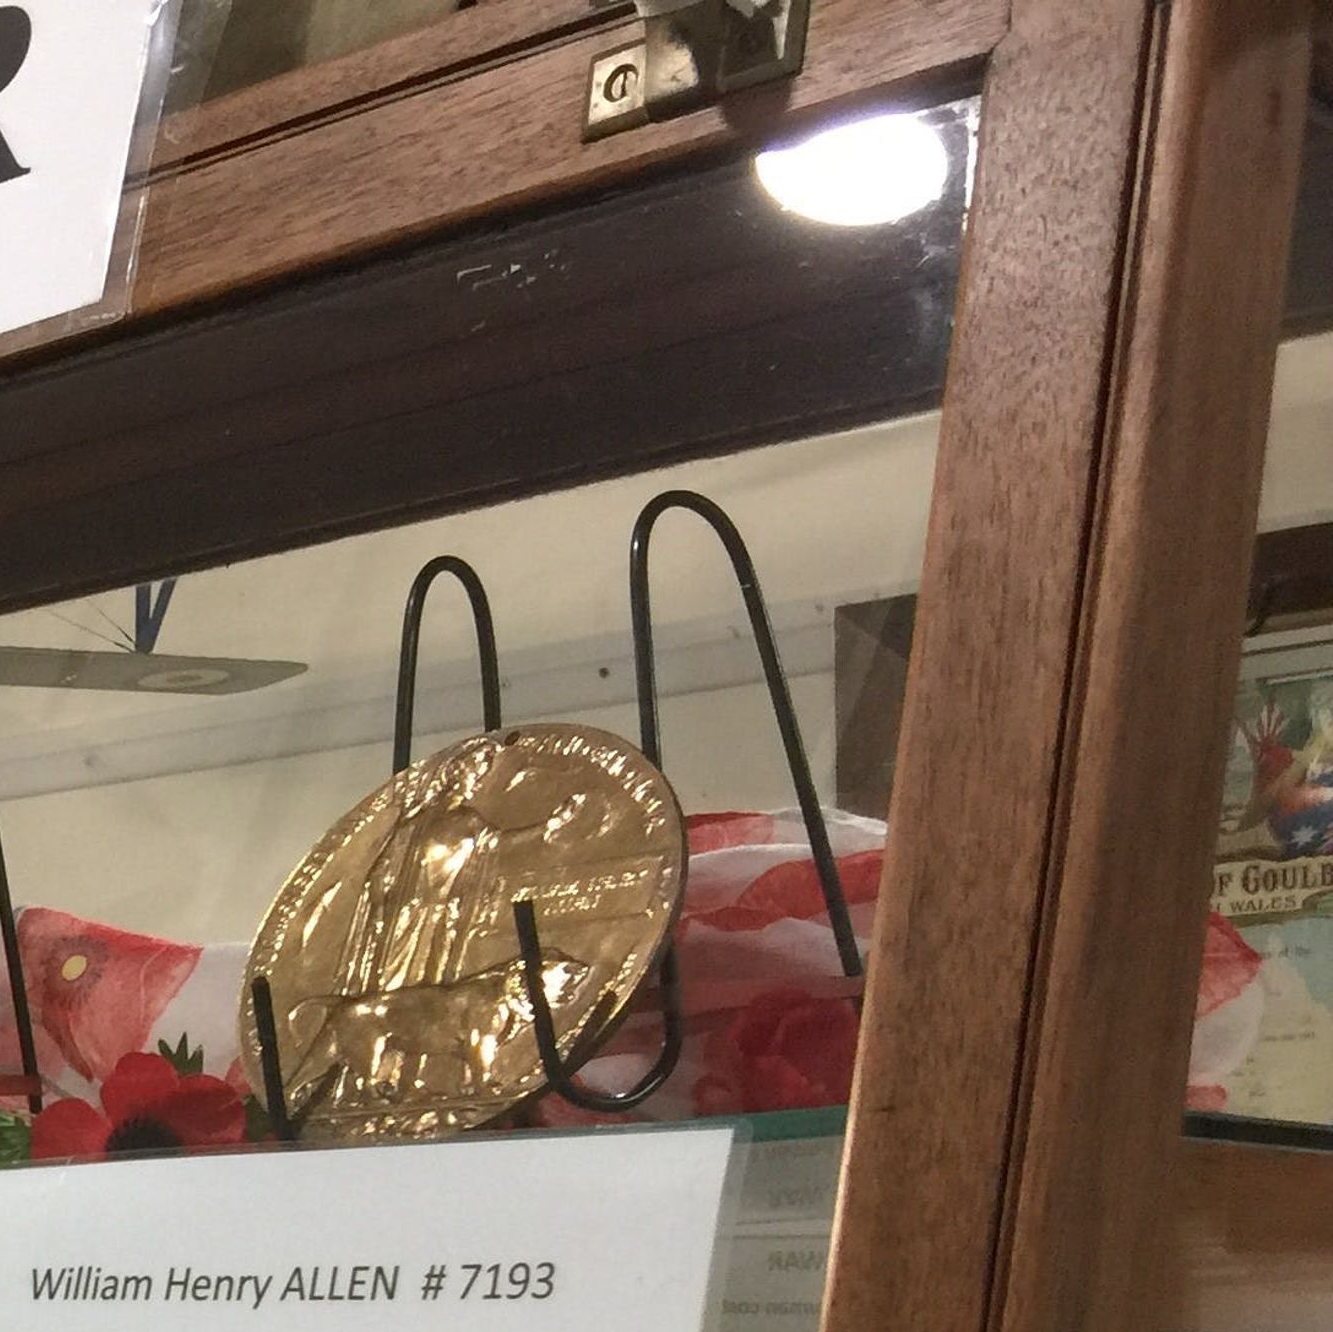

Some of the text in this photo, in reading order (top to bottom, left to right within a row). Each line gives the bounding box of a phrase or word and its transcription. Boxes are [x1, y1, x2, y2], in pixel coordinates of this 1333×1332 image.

[32, 1262, 555, 1310] William Henry ALLEN # 7193
